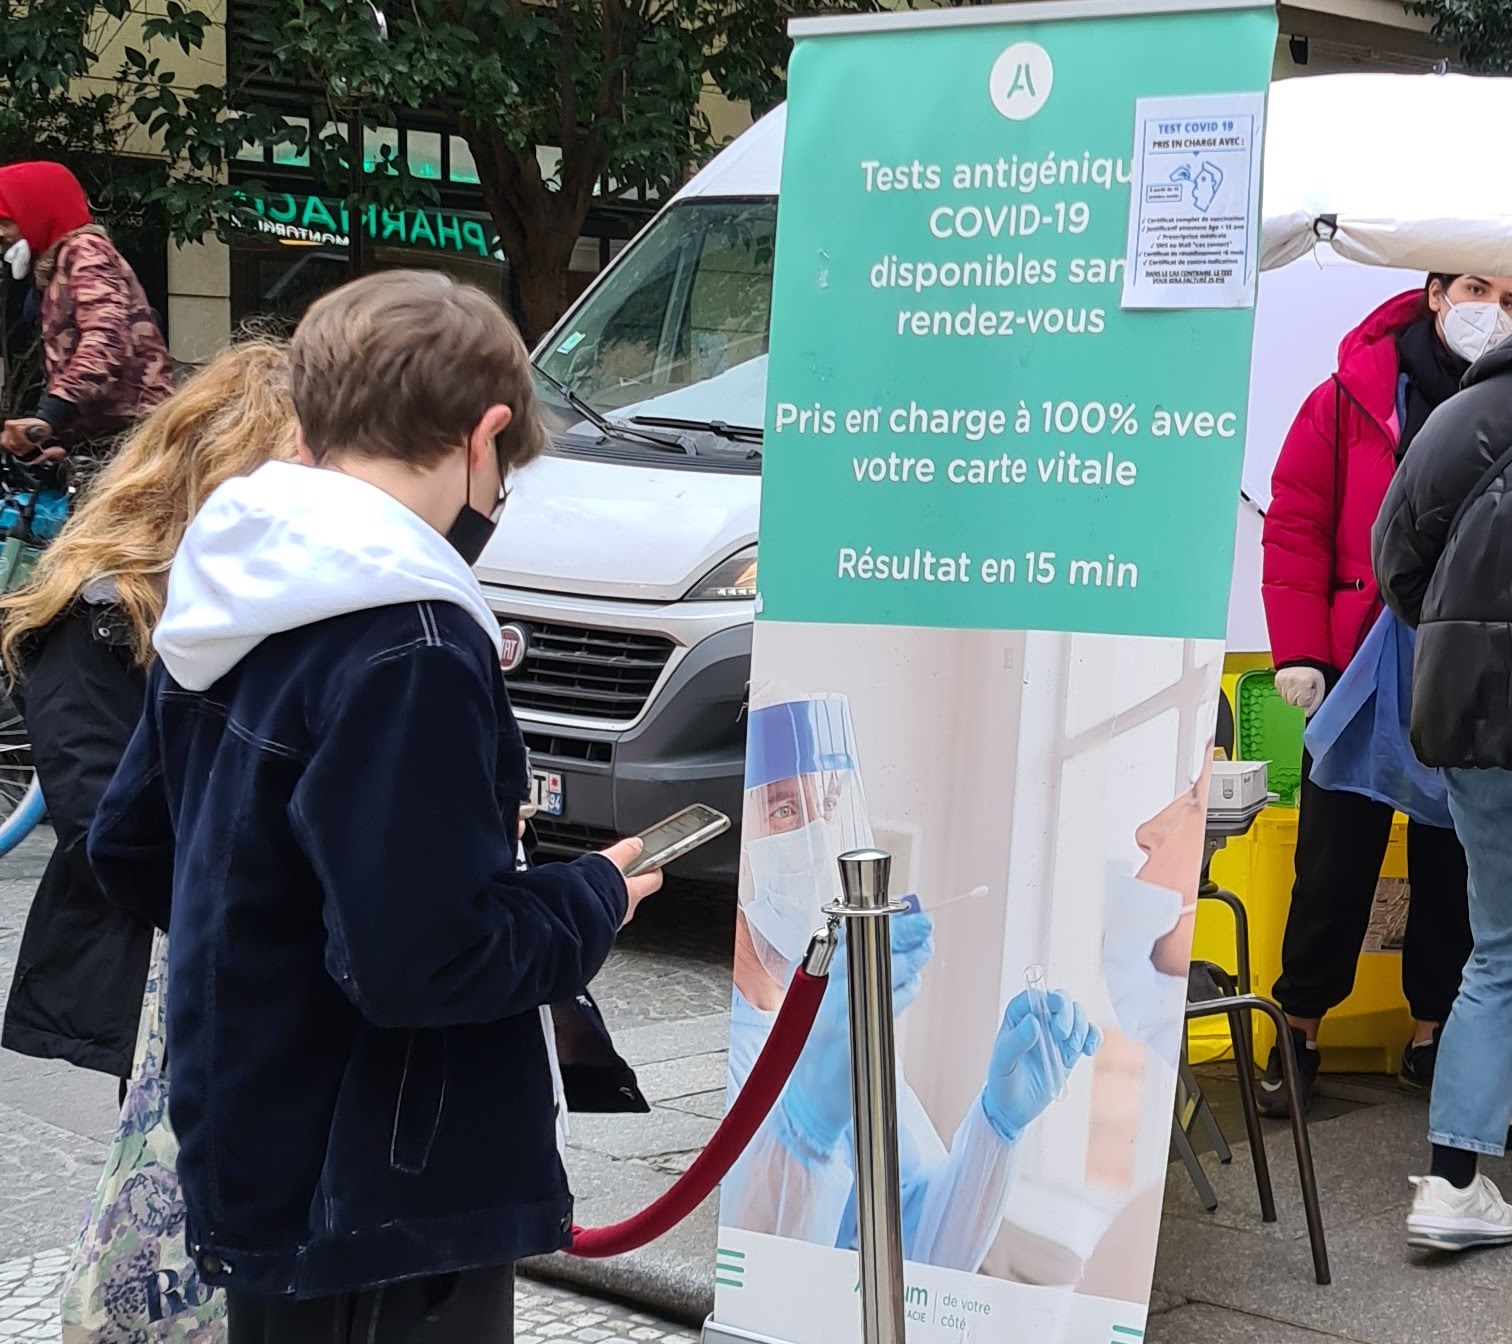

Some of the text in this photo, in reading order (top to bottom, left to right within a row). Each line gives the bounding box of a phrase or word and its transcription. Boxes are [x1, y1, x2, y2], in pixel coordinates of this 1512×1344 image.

[1152, 137, 1240, 149] PRIS EN CHARGE AVEC
[1158, 121, 1234, 135] TEST COVID 19
[861, 152, 1132, 193] Tests antigéniqu
[929, 203, 1090, 238] COVID-19
[871, 252, 1127, 293] disponibles san
[897, 305, 1106, 337] rendez-vous
[774, 400, 1237, 442] Pris en charge à 100% avec
[853, 452, 1138, 488] votre carte vitale
[837, 546, 1139, 588] Résultat en 15 min
[532, 774, 547, 806] T
[943, 1294, 991, 1315] de votre
[941, 1315, 966, 1331] côté
